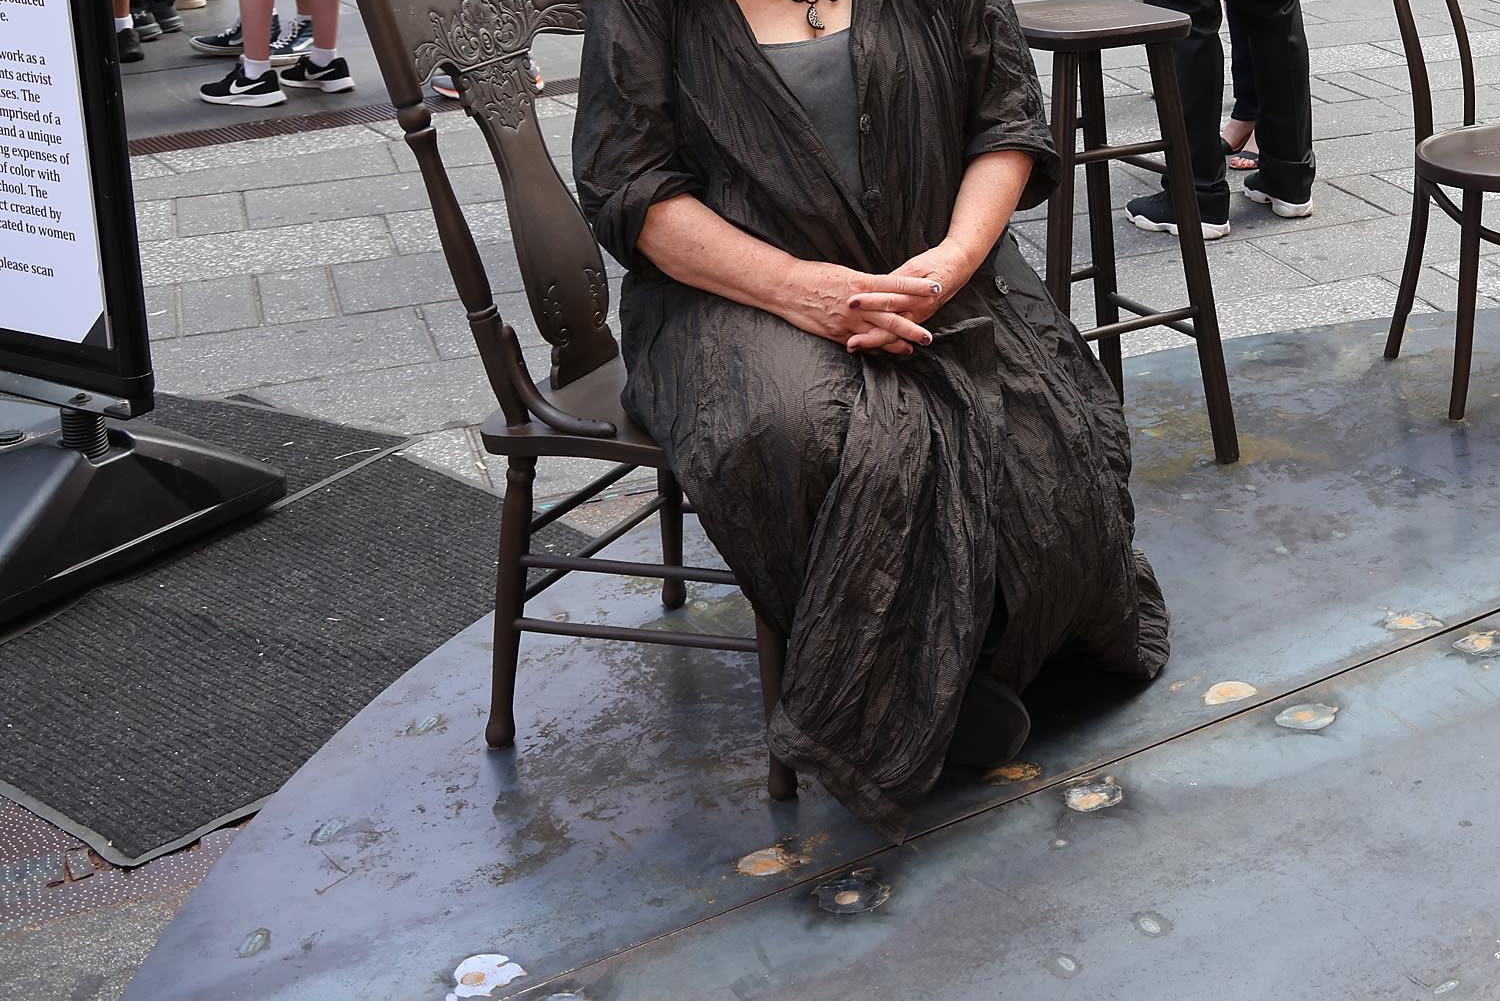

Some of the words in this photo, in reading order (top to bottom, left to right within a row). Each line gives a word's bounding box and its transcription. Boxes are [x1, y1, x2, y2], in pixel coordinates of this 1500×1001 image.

[26, 53, 38, 64] as
[39, 55, 46, 65] a
[15, 71, 53, 86] activist
[0, 88, 20, 100] ses.
[20, 88, 41, 103] The
[42, 112, 53, 125] of
[55, 116, 62, 126] a
[18, 129, 26, 139] a
[27, 130, 63, 146] unique
[11, 147, 58, 162] expenses
[59, 153, 70, 165] of
[9, 164, 35, 178] color
[37, 169, 61, 183] with
[28, 184, 48, 199] The
[10, 202, 48, 218] created
[49, 206, 62, 223] by
[25, 223, 36, 235] to
[38, 226, 76, 242] women
[31, 264, 55, 278] scan
